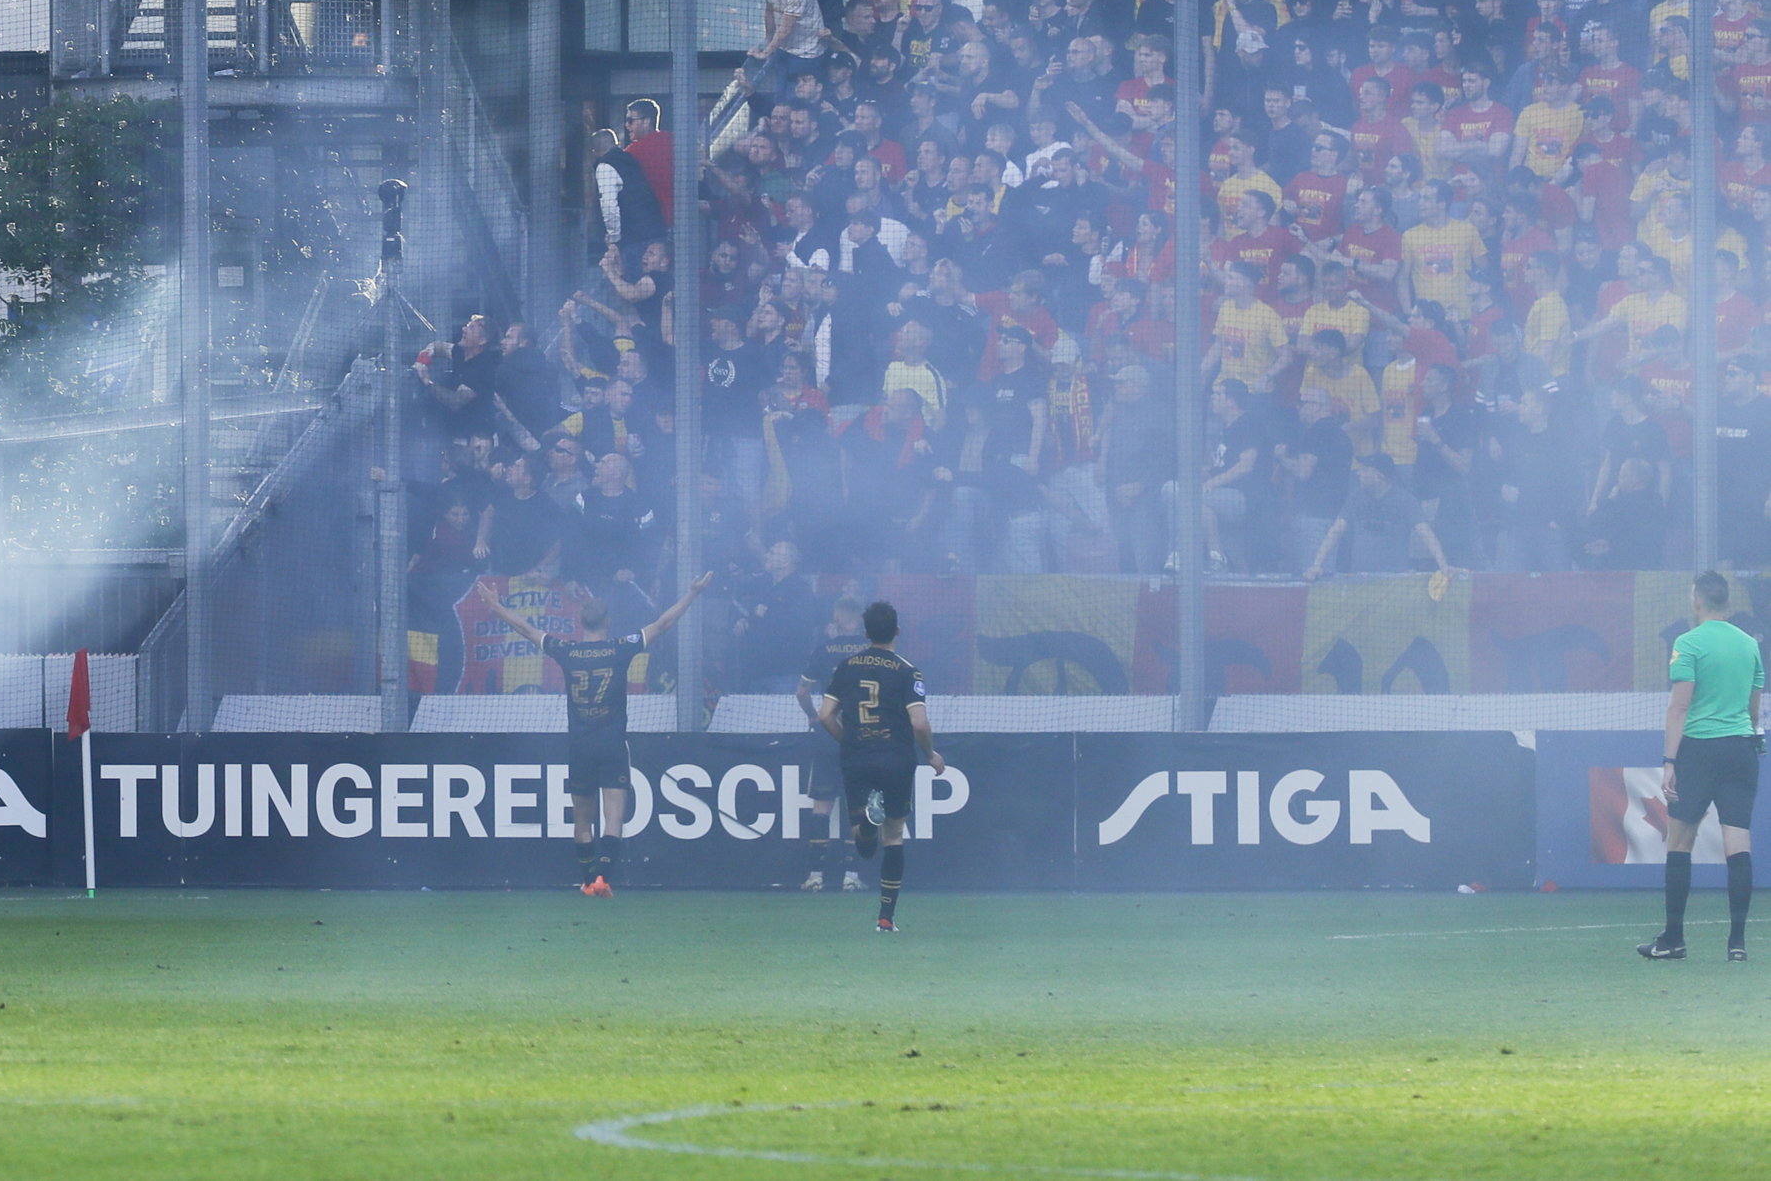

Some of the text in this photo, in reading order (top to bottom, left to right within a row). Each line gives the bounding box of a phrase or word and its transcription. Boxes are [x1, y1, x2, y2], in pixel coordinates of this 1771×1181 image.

[475, 615, 575, 637] DIEARDS
[475, 640, 543, 662] DEVEN
[826, 644, 870, 653] VALIDSIG
[848, 655, 901, 671] VALIDSIGN
[571, 668, 614, 705] 27
[859, 680, 880, 724] 2
[100, 763, 970, 840] TUINGEREEDSCHP
[1099, 769, 1431, 846] STIGA
